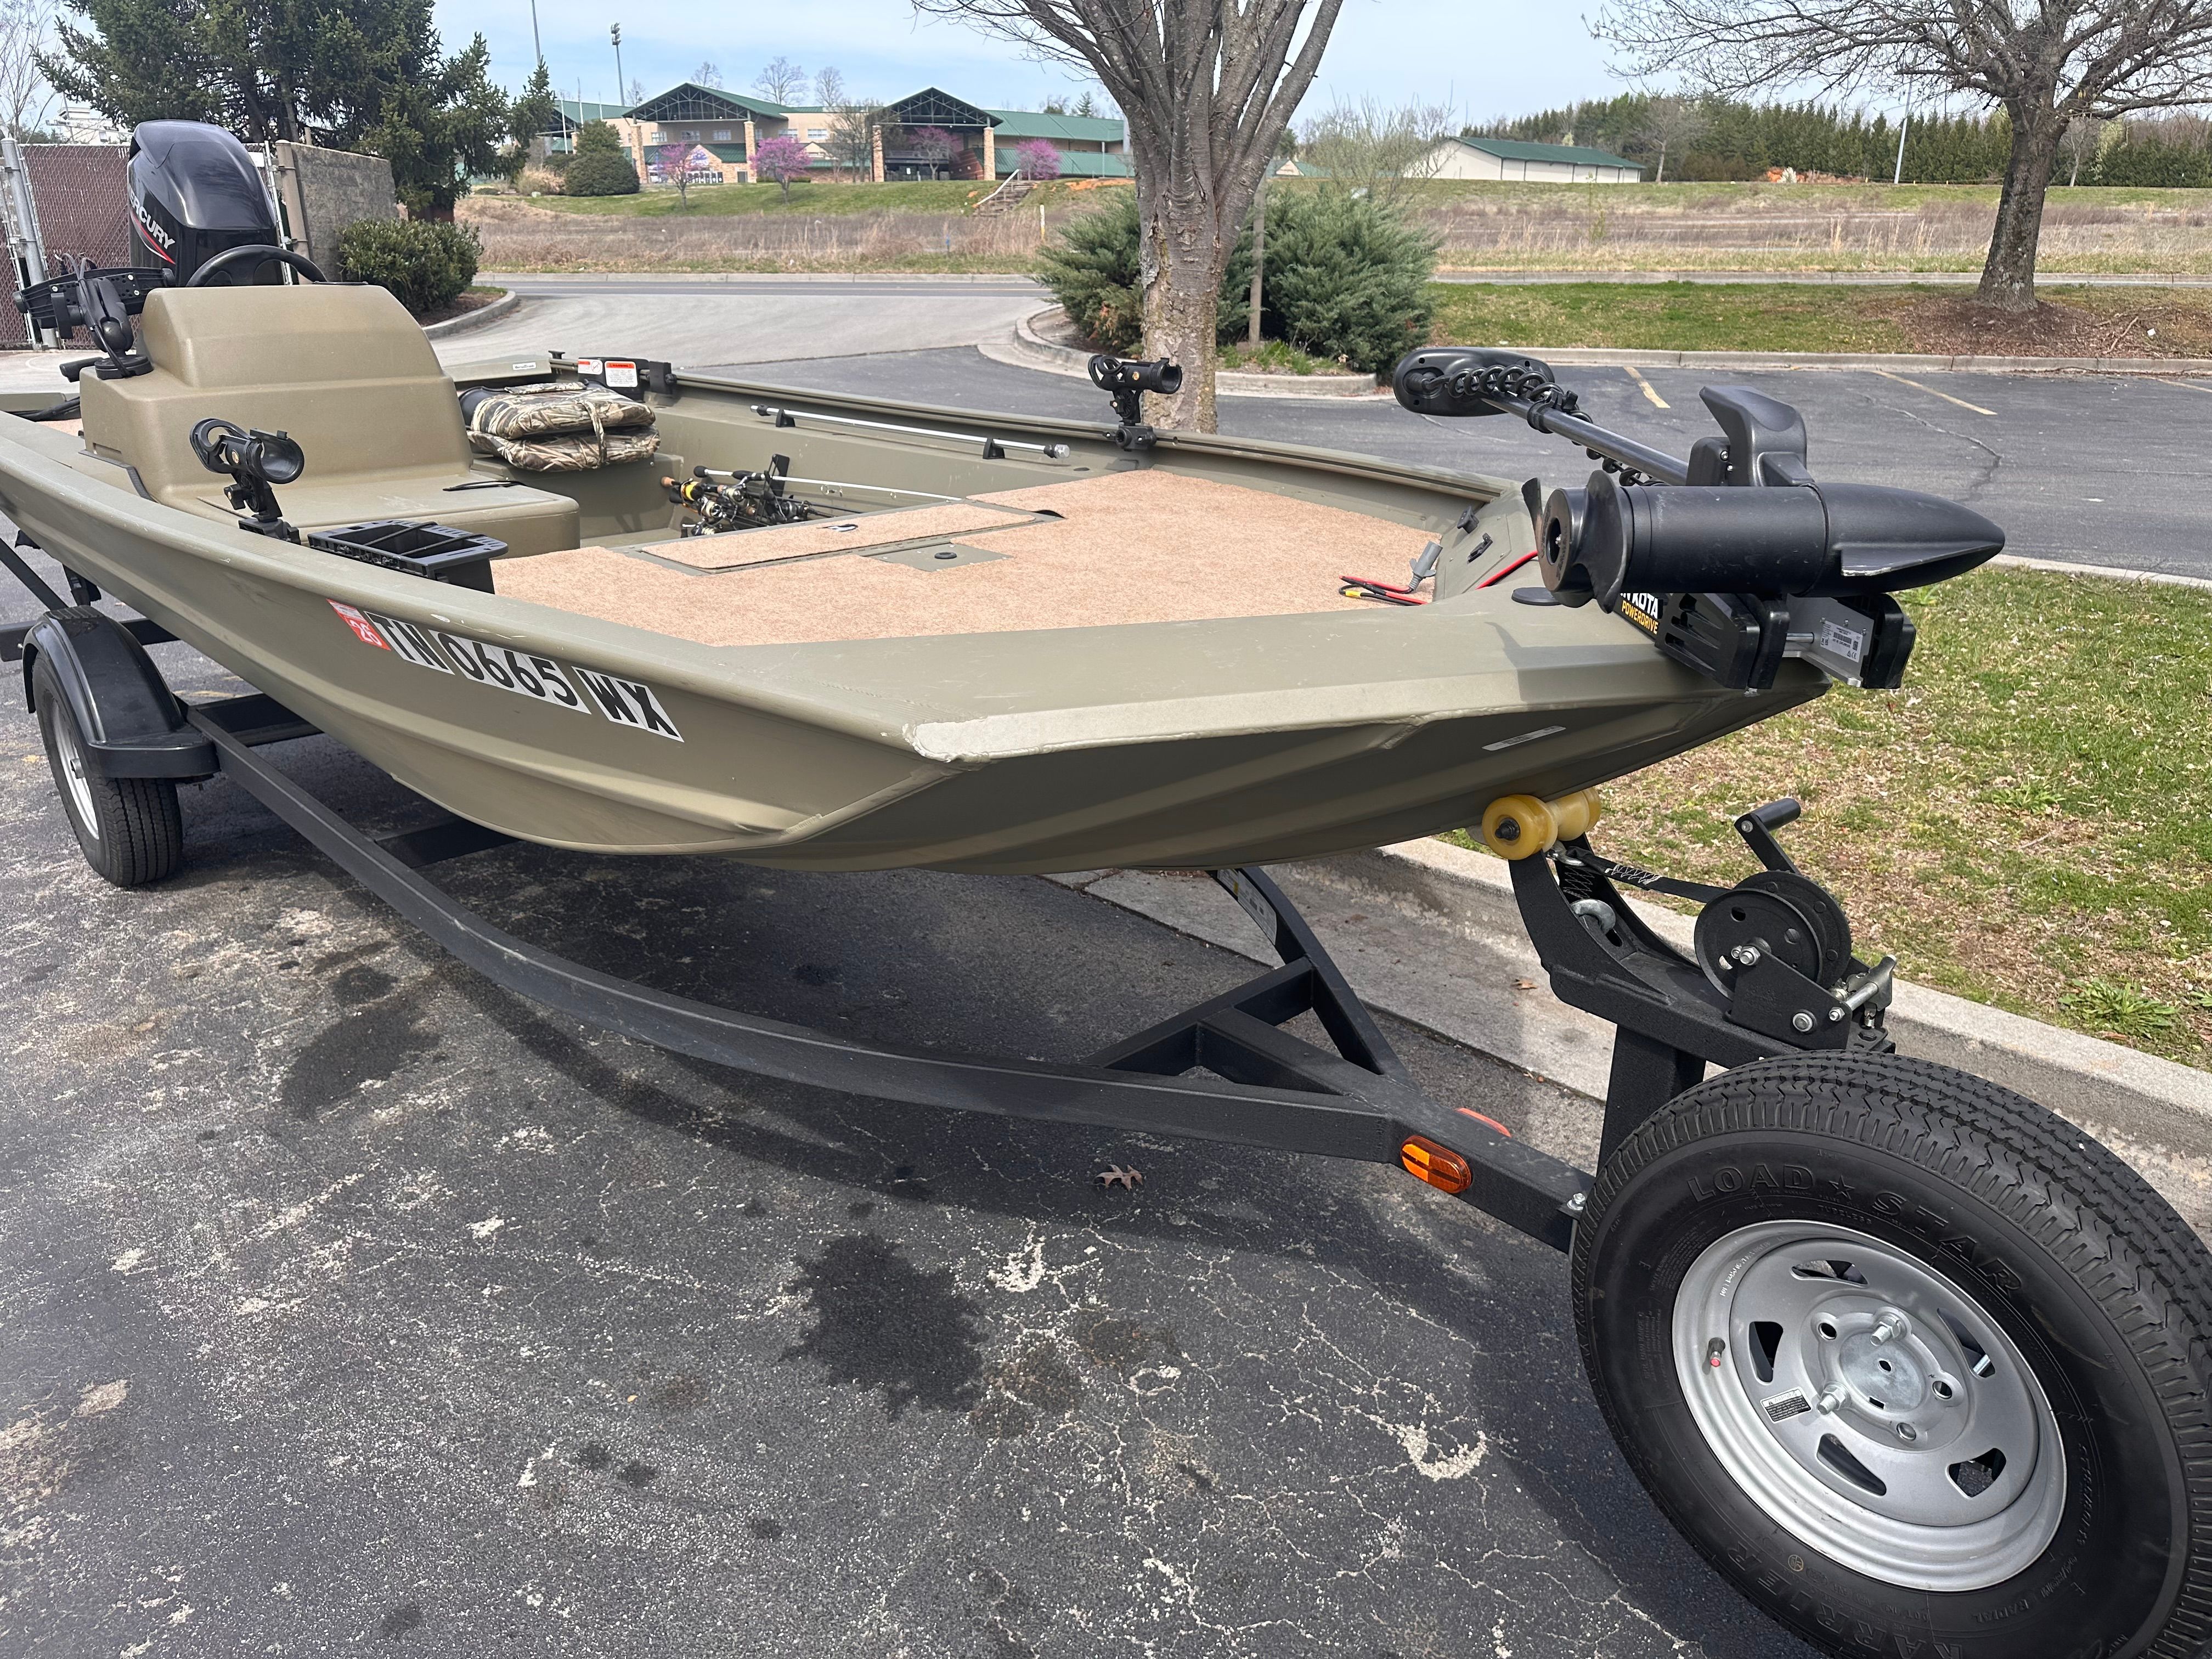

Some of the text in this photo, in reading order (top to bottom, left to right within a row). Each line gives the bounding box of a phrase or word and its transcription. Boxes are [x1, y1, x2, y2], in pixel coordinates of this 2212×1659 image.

[128, 184, 176, 250] ERCURY
[1622, 600, 1659, 635] POWERDRIVE
[1632, 593, 1658, 619] KOTA
[366, 612, 680, 738] TN 0665 WX
[1686, 1164, 1815, 1203] LOAD
[1871, 1191, 2022, 1298] STAR
[1727, 1541, 1962, 1659] KARRIER
